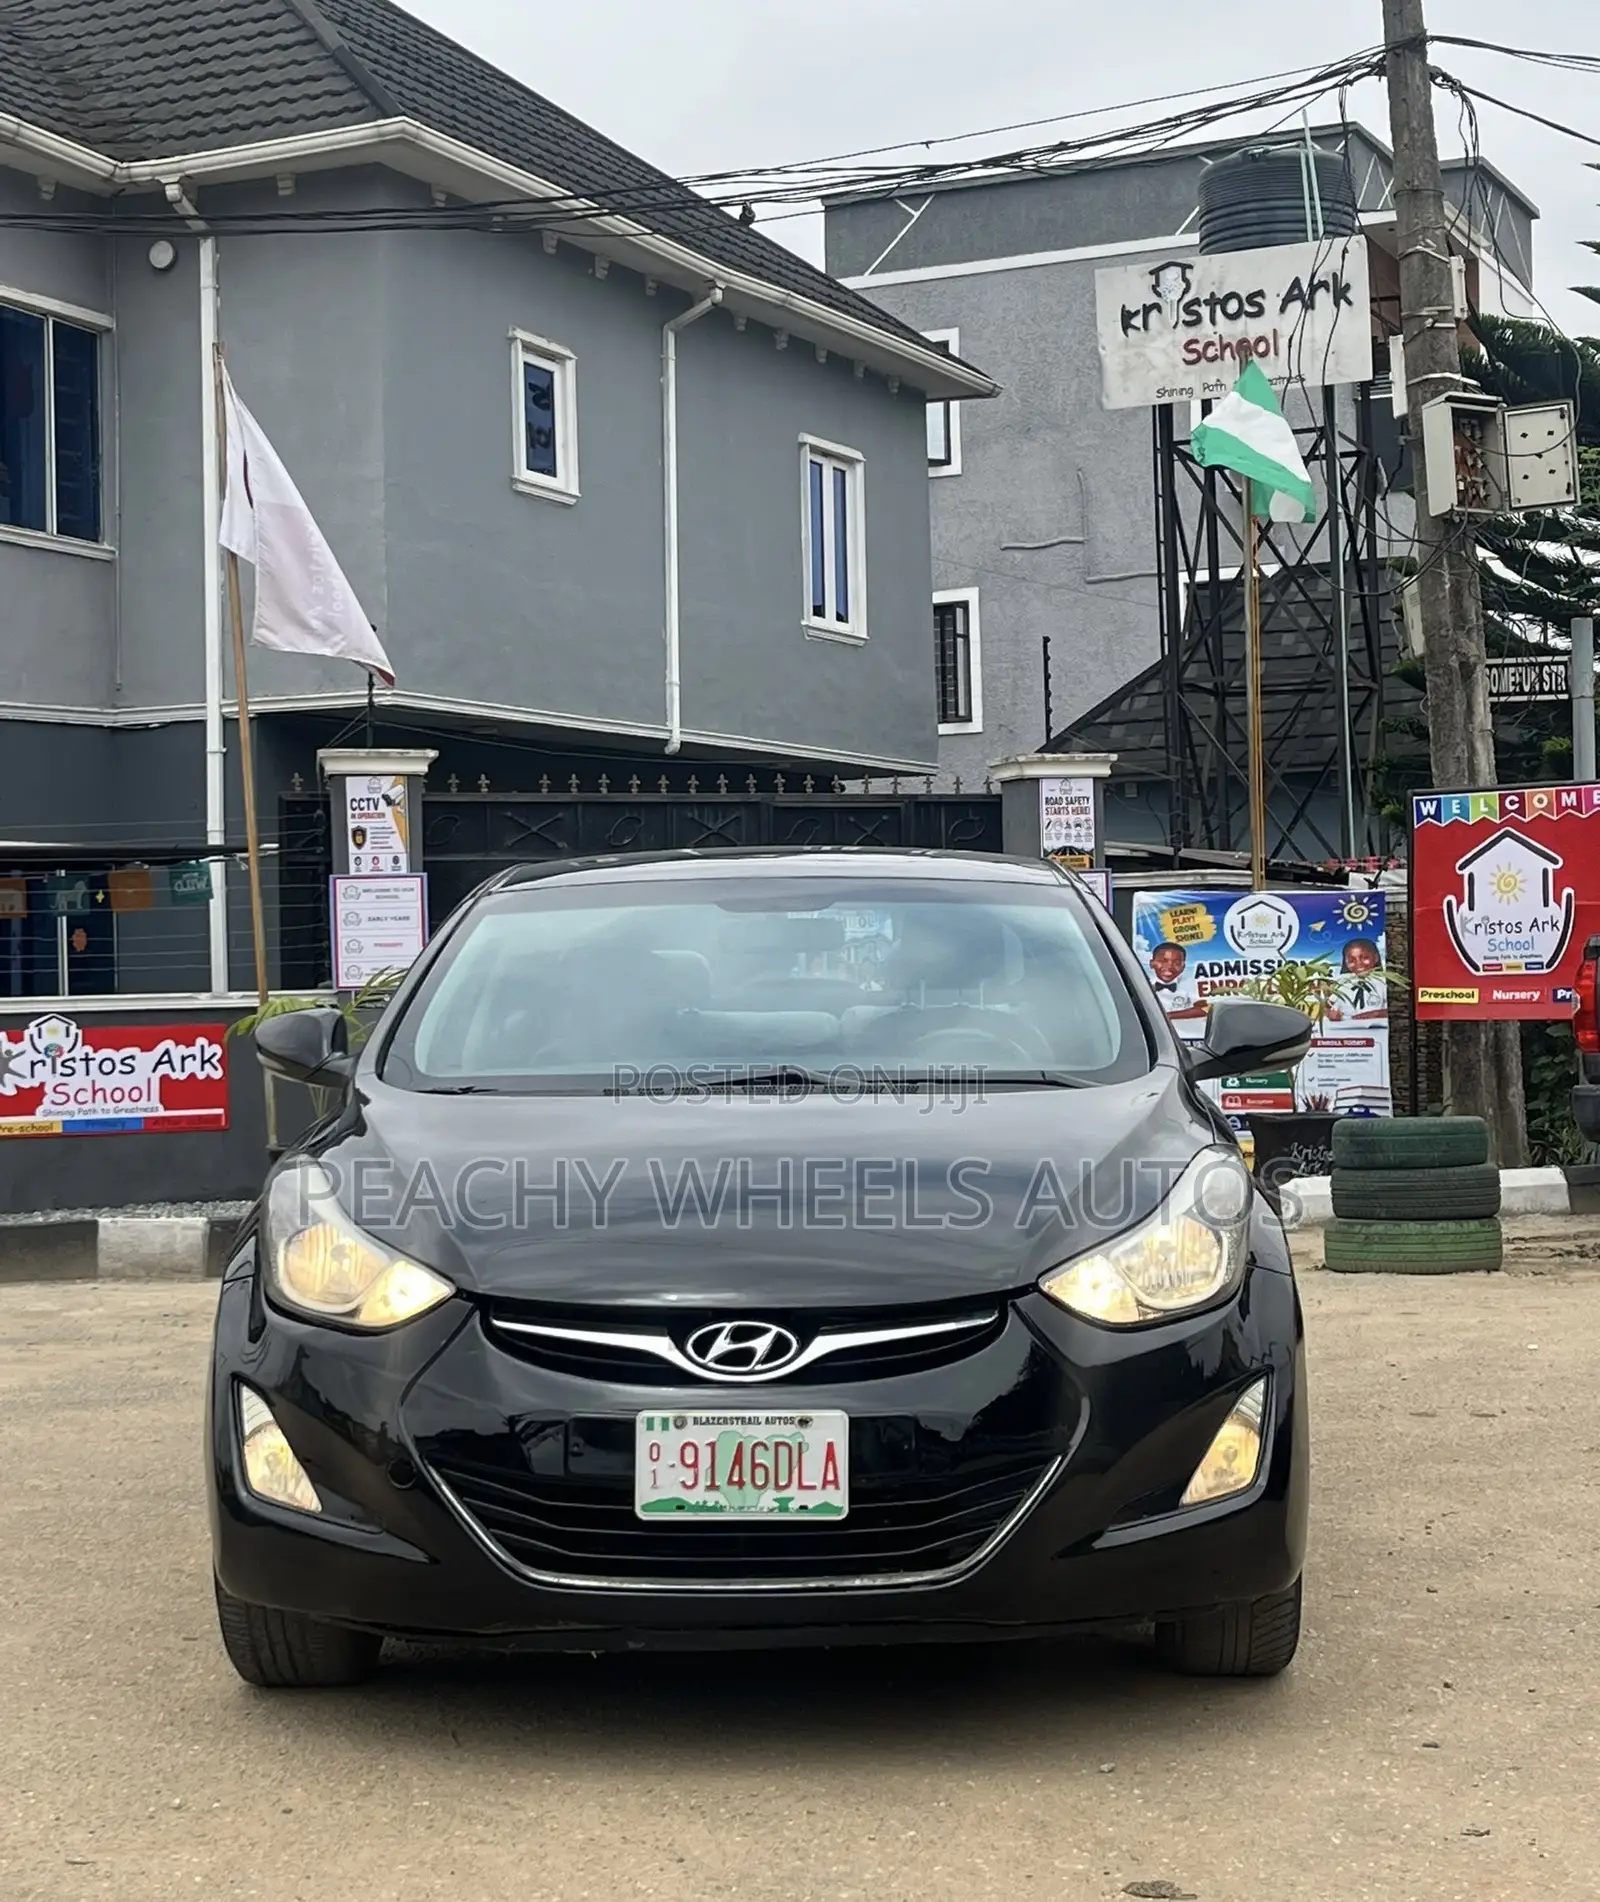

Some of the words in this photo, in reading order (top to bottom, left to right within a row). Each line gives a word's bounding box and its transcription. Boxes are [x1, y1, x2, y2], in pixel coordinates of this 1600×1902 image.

[1279, 272, 1354, 314] Ark
[1156, 385, 1195, 400] Shining
[1202, 378, 1227, 393] Path
[1543, 665, 1566, 692] STR
[350, 797, 380, 811] CCTV
[1045, 796, 1064, 806] ROAD
[1065, 796, 1090, 806] SAFETY
[1420, 789, 1600, 816] WELCOME
[1045, 806, 1069, 816] STARTS
[1461, 916, 1523, 940] Kristos
[1529, 916, 1561, 934] Ark
[1487, 938, 1535, 953] School
[1421, 990, 1476, 999] Preschool
[1493, 990, 1541, 1001] Nursery
[152, 1044, 219, 1073] Ark
[50, 1078, 152, 1105] School
[42, 1107, 76, 1118] Shining
[77, 1108, 98, 1116] Path
[101, 1107, 111, 1115] to
[113, 1105, 160, 1115] Greatness
[692, 1416, 762, 1426] BLAZERSTRAIL
[764, 1416, 795, 1426] AUTOS
